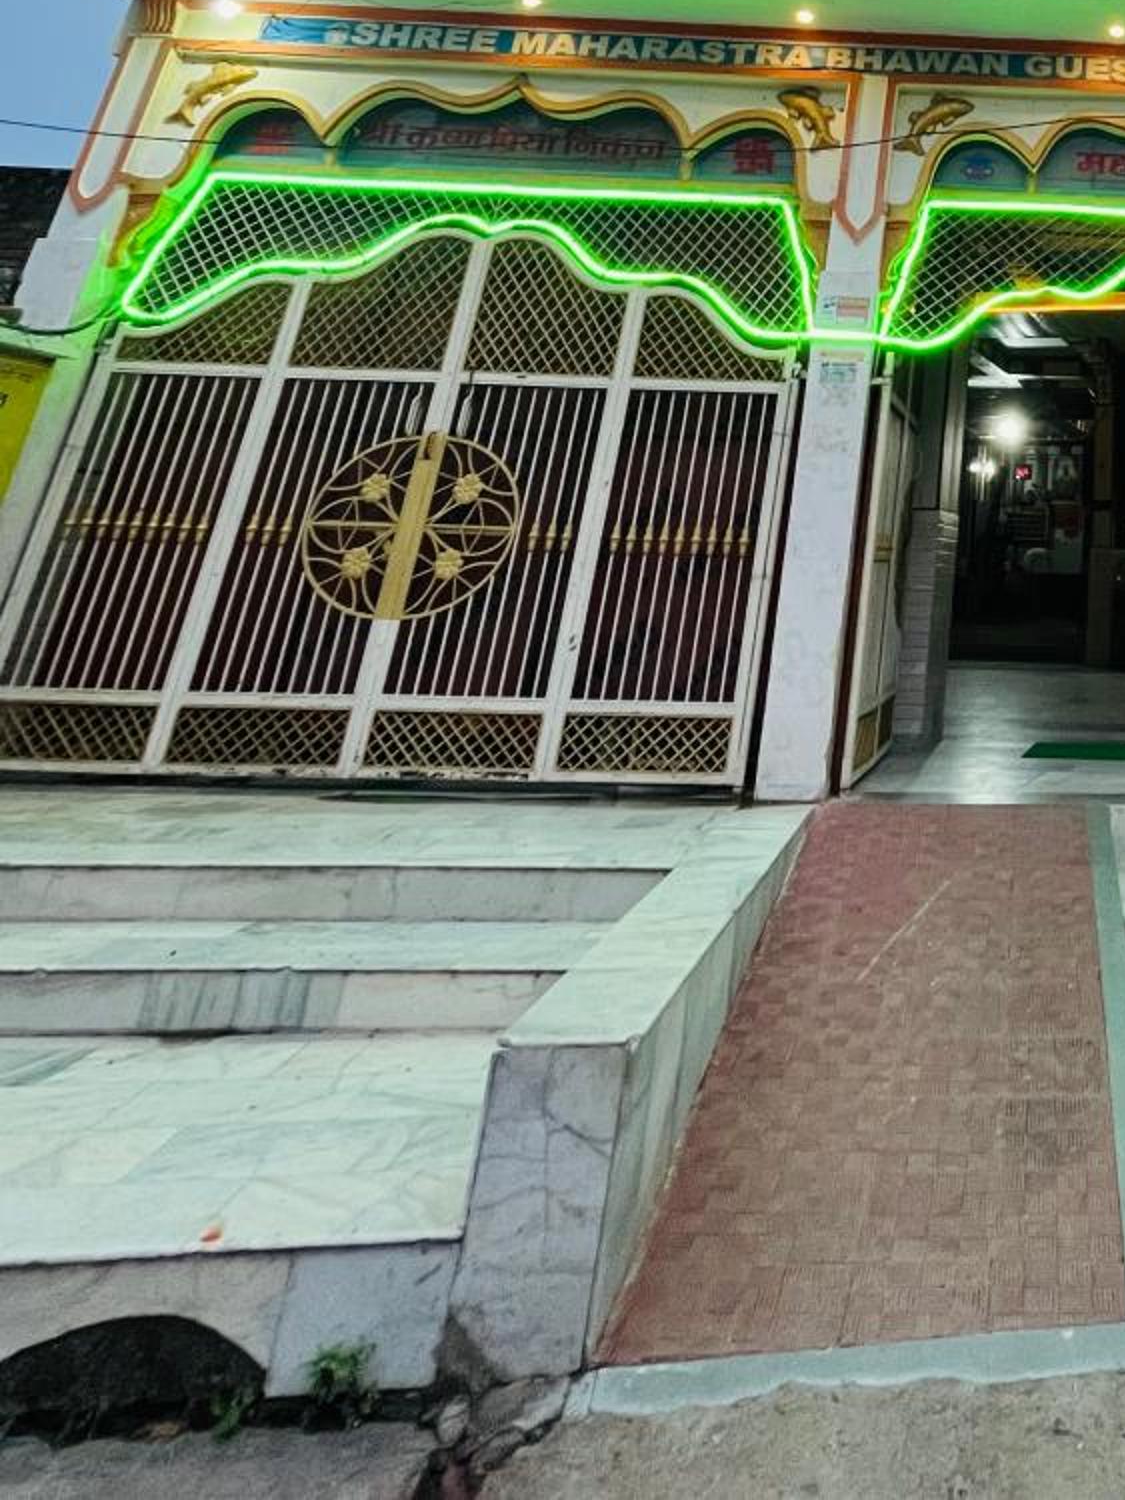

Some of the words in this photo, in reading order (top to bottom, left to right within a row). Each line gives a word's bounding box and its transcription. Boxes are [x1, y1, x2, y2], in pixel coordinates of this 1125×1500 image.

[350, 23, 499, 52] SHREE
[511, 30, 811, 68] MAHARASTRA
[825, 46, 1008, 76] BHAWAN
